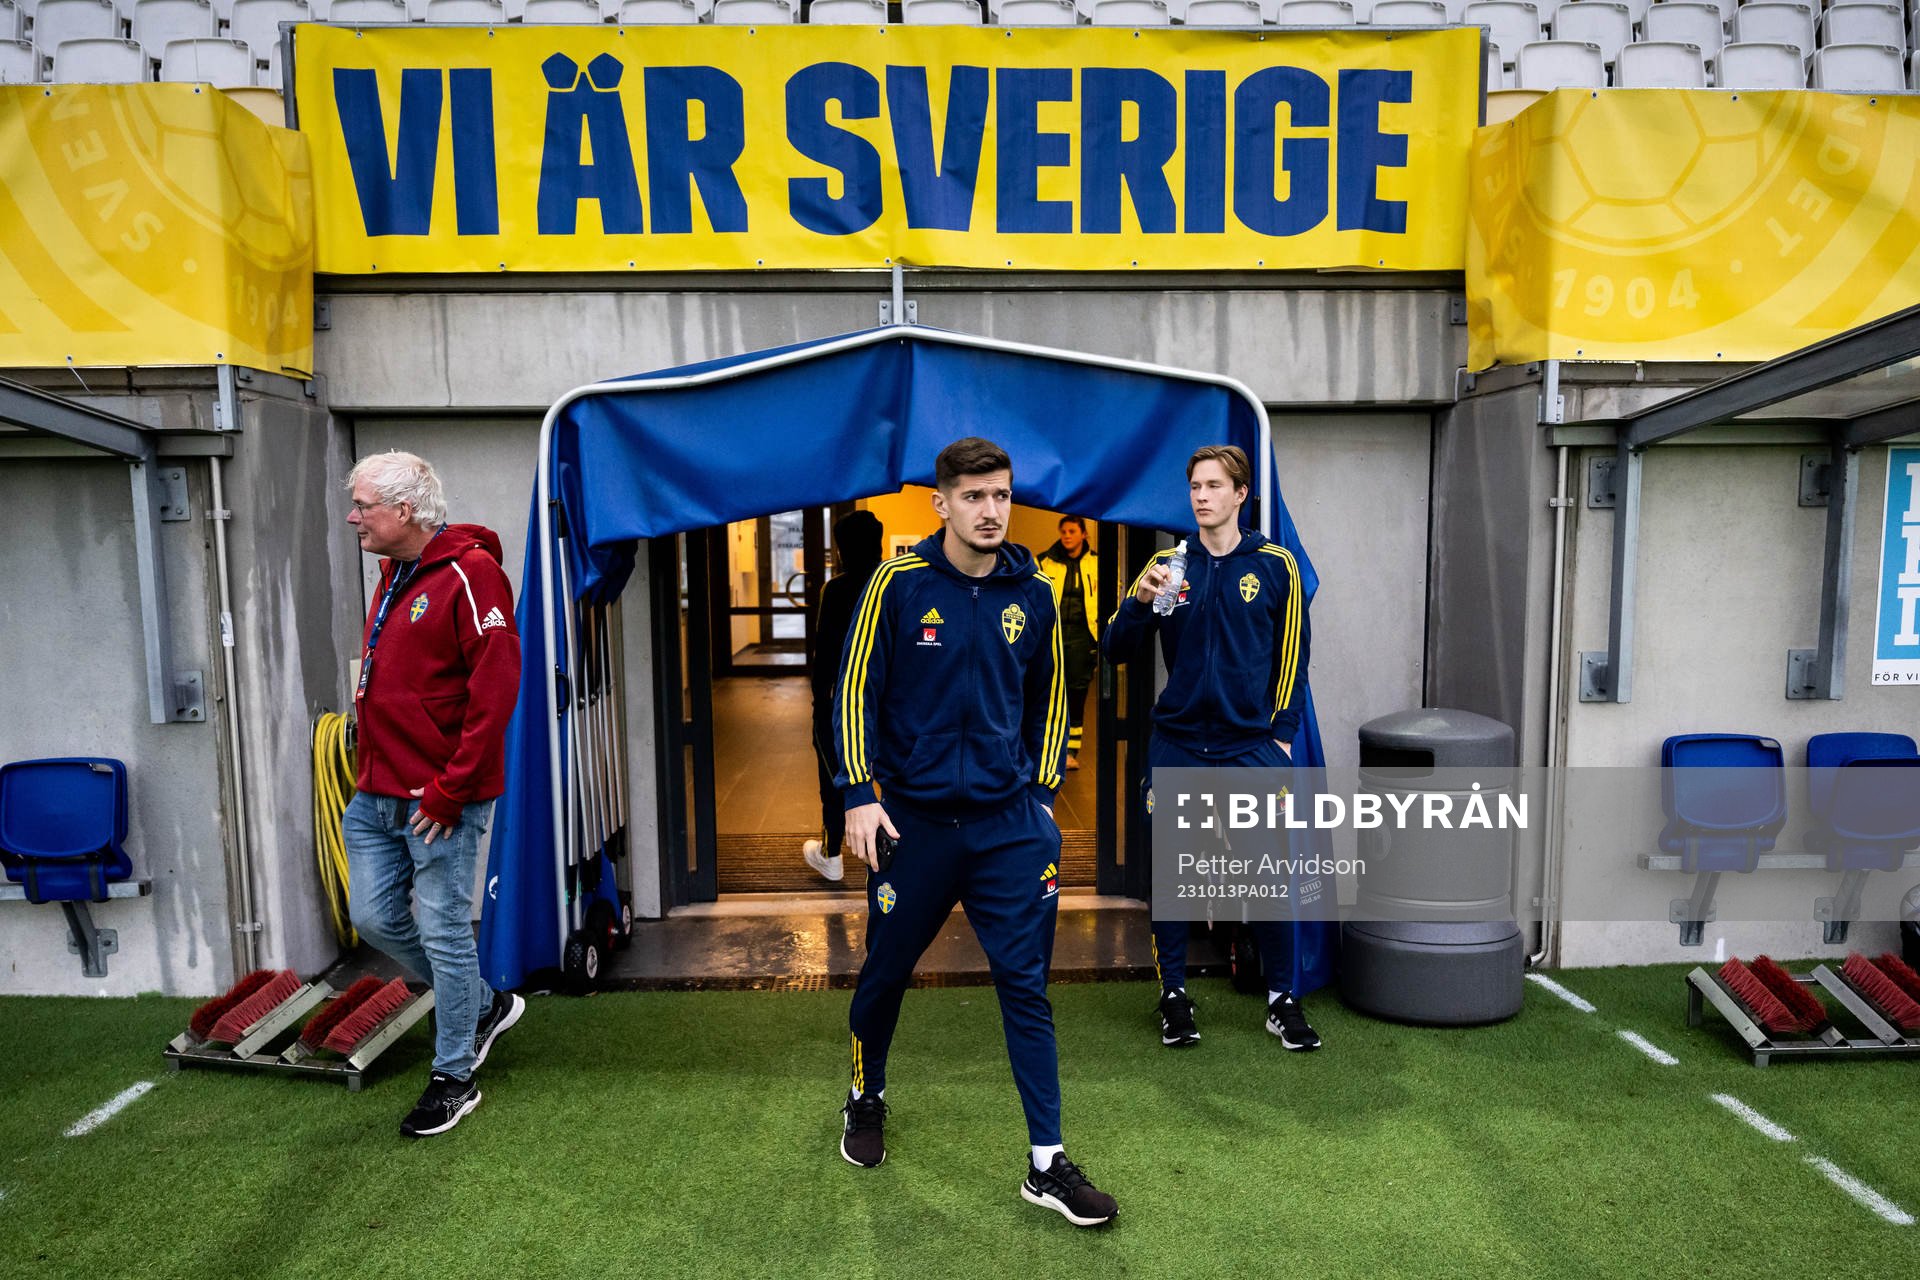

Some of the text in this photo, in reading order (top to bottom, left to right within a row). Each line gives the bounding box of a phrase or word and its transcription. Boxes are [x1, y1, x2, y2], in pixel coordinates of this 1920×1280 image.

[333, 52, 1413, 237] VI ÄR SVERIGE
[1553, 268, 1700, 318] 1904
[1875, 671, 1899, 681] FÖR
